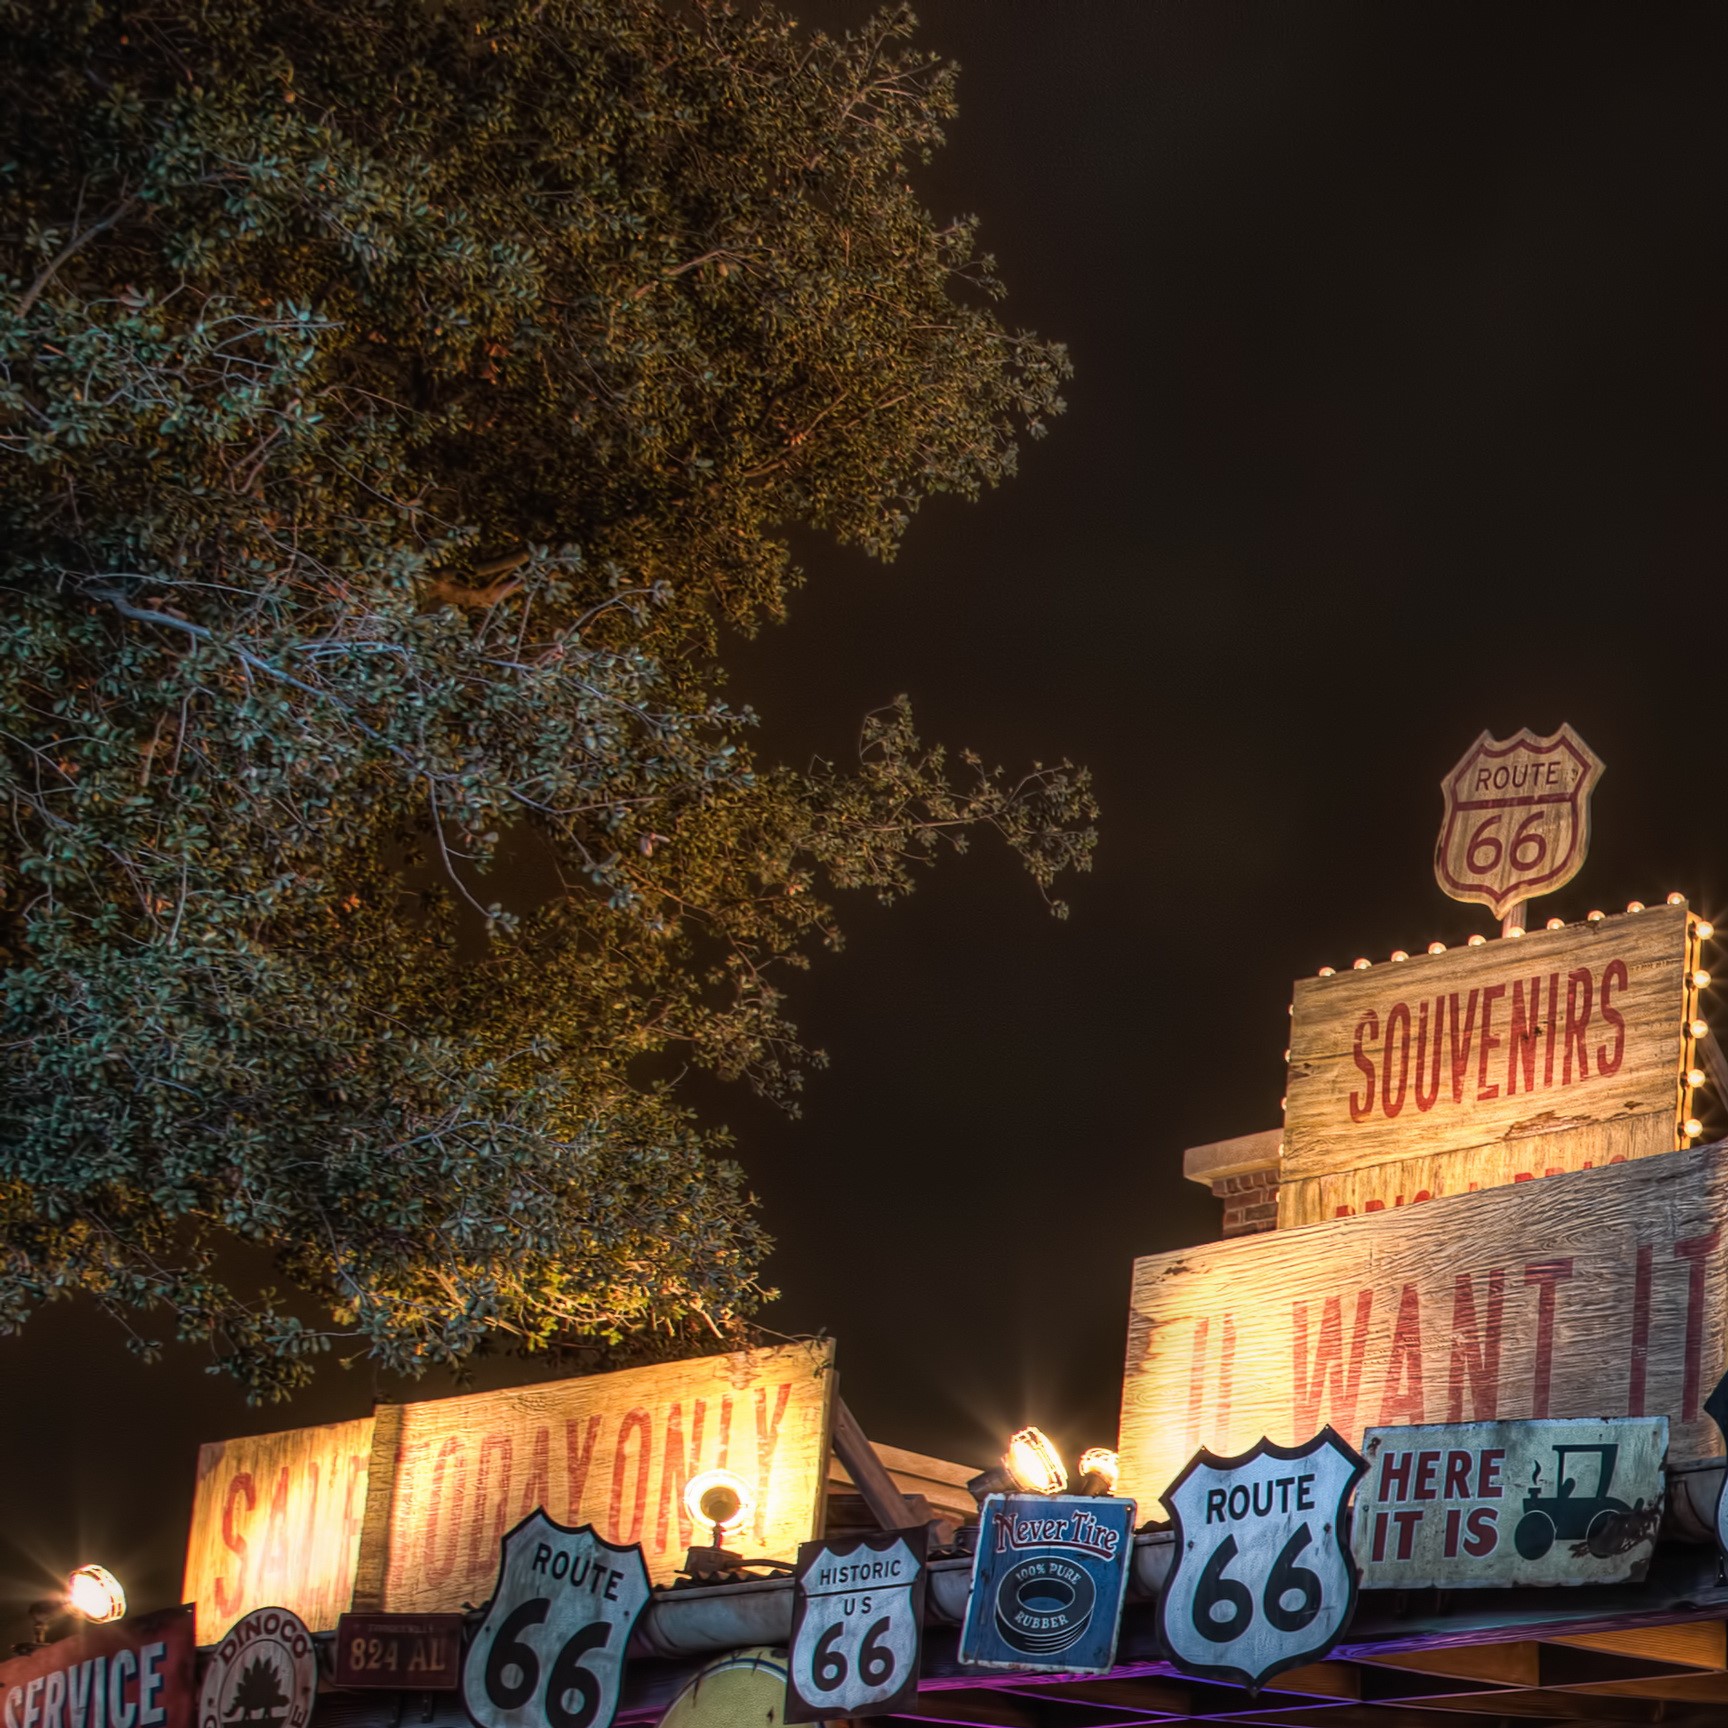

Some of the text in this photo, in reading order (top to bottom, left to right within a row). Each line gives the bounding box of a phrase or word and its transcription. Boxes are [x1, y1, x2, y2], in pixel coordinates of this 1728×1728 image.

[1473, 760, 1562, 794] ROUTE
[1465, 810, 1547, 876] 66
[1349, 957, 1630, 1126] SOUVENIRS
[1292, 1256, 1575, 1446] WANT
[1628, 1230, 1722, 1423] IT
[1204, 1473, 1316, 1525] ROUTE
[1378, 1448, 1507, 1503] HERE
[993, 1510, 1120, 1556] Never Tire
[1371, 1507, 1500, 1563] IT IS
[531, 1541, 626, 1602] ROUTE
[819, 1558, 902, 1584] HISTORIC
[1014, 1562, 1082, 1585] 100% PURE
[1190, 1520, 1324, 1644] 66
[843, 1595, 873, 1617] US
[1014, 1612, 1068, 1630] RUBBER
[218, 1612, 310, 1665] DINOCO
[350, 1638, 445, 1672] 824 AL
[811, 1614, 895, 1693] 66
